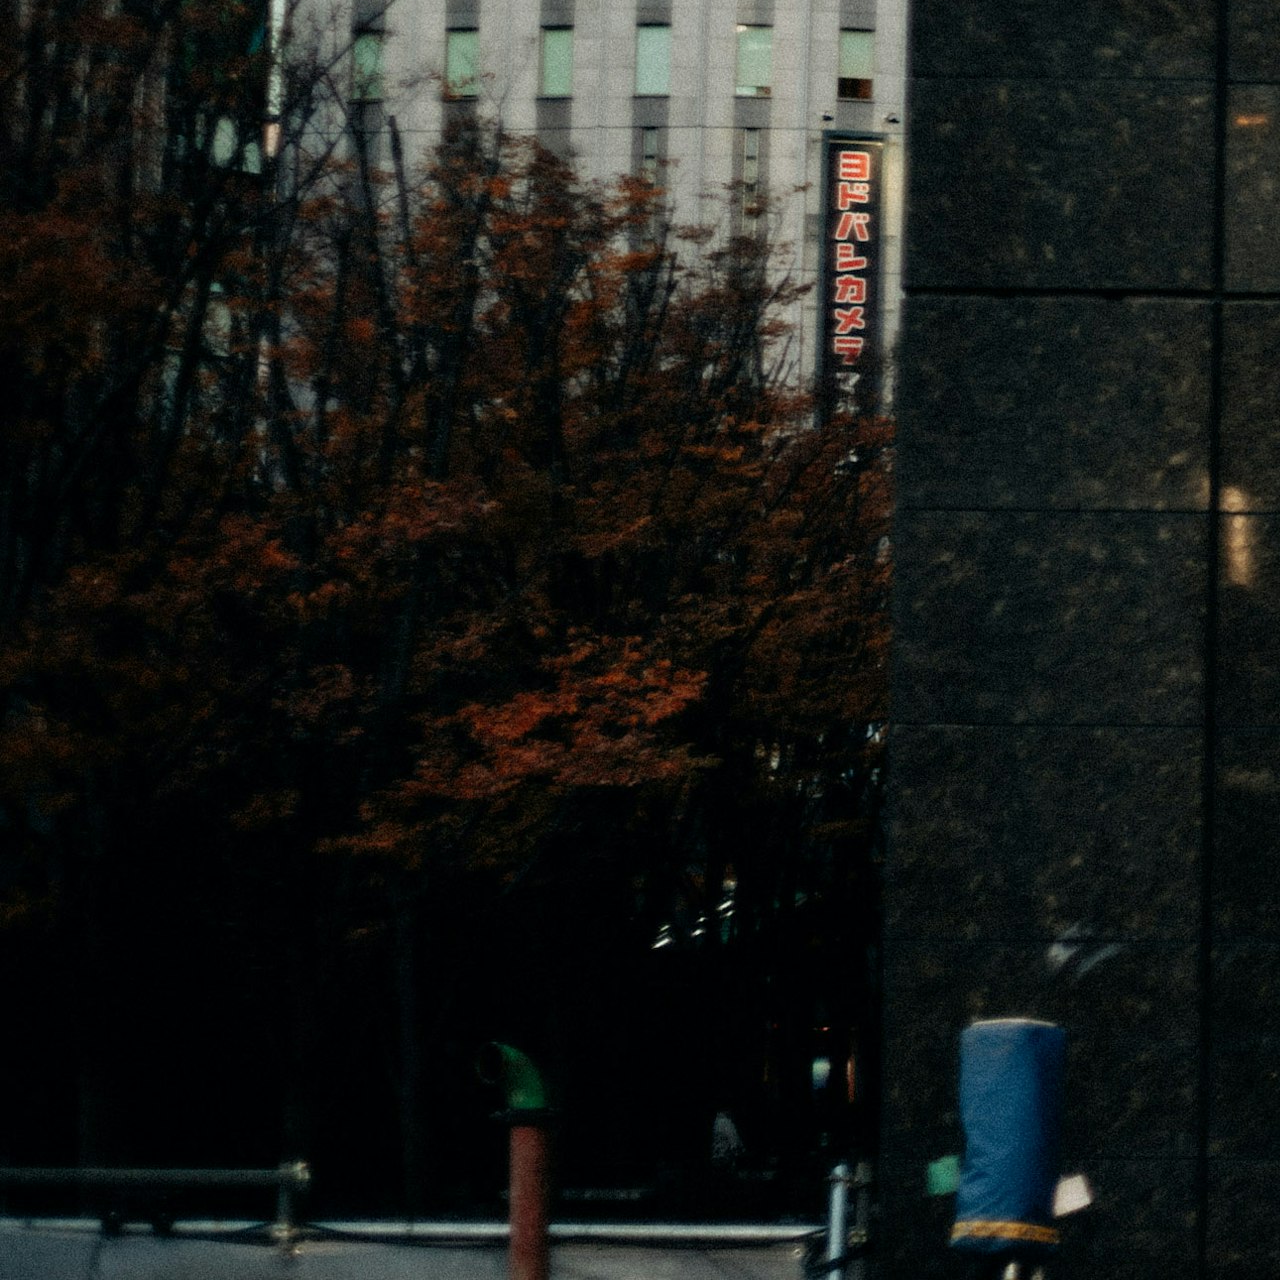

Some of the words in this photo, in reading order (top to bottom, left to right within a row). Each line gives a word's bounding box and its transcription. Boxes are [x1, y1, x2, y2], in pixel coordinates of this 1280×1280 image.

[835, 150, 871, 366] ヨドバシカメラ
